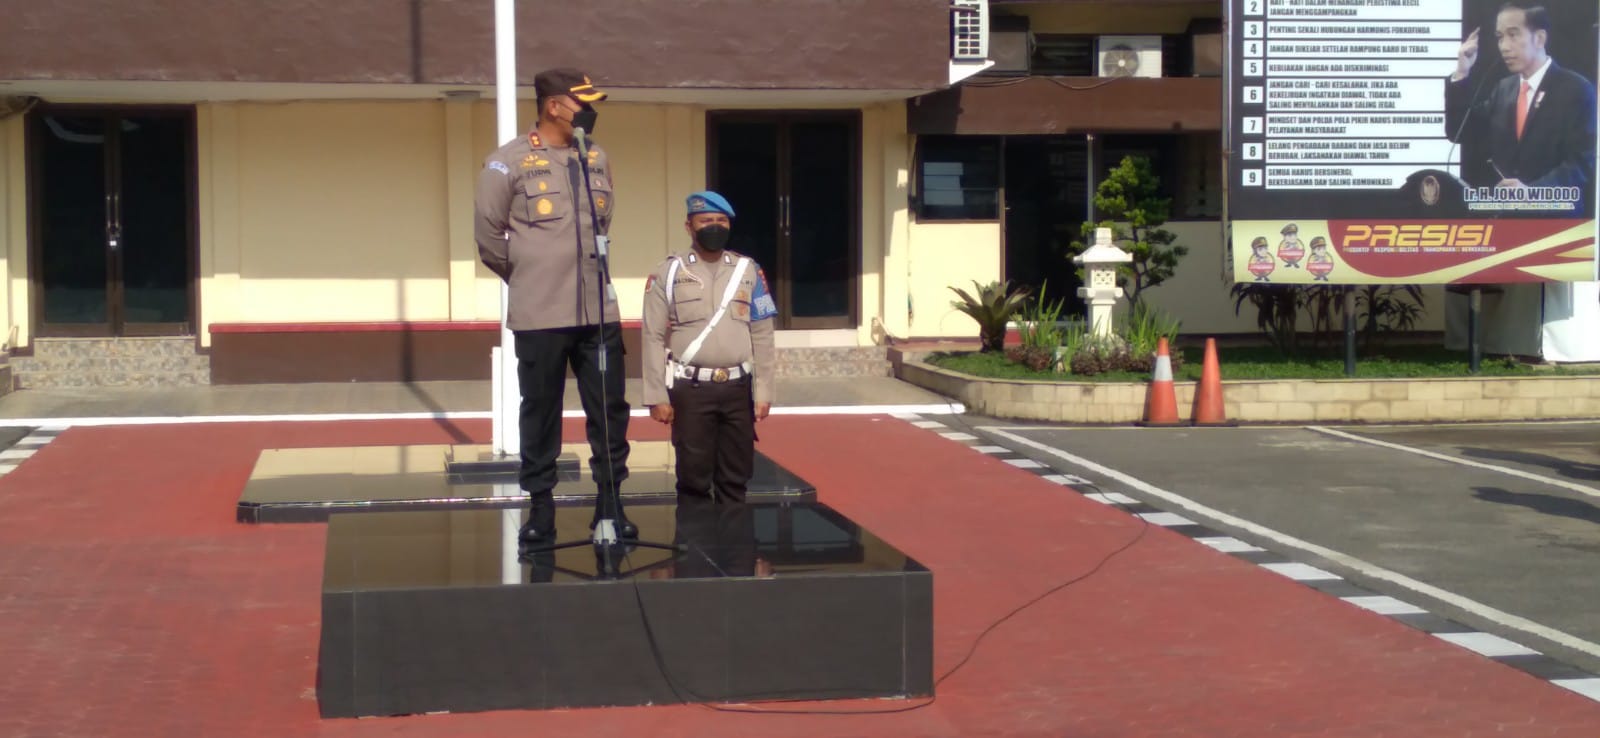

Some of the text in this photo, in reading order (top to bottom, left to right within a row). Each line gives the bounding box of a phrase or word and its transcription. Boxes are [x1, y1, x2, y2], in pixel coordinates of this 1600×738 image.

[1250, 2, 1257, 13] 2
[1269, 8, 1358, 16] JANGAN MENGGAMPANGKAN
[1250, 24, 1257, 35] 3
[1269, 26, 1296, 34] PENTING
[1297, 26, 1319, 34] SEKALI
[1320, 26, 1356, 34] HUBUNGAN
[1357, 26, 1390, 34] HARMONIS
[1250, 44, 1257, 55] 4
[1269, 45, 1294, 53] JANGAN
[1295, 45, 1321, 53] DIKEJAR
[1322, 45, 1348, 53] SETELAH
[1349, 45, 1381, 53] RAMPUNG
[1382, 45, 1400, 53] BARU
[1401, 45, 1408, 53] DI
[1250, 63, 1257, 74] 5
[1269, 64, 1390, 72] KEBIJAKAN JANGAN ADA DISKRIMINASI
[1269, 81, 1294, 89] JANGAN
[1295, 81, 1310, 89] CARI
[1315, 81, 1331, 89] CARI
[1370, 81, 1384, 89] JIKA
[1250, 89, 1257, 100] 6
[1308, 91, 1340, 99] INGATKAN
[1368, 91, 1387, 99] TIDAK
[1388, 91, 1402, 99] ADA
[1269, 101, 1396, 109] SALING MENYALAHKAN DAN SALING JEGAL
[1268, 116, 1297, 124] MINDSET
[1298, 116, 1311, 124] DAN
[1334, 116, 1350, 124] POLA
[1351, 116, 1369, 124] PIKIR
[1370, 116, 1391, 124] HARUS
[1422, 116, 1444, 124] DALAM
[1250, 119, 1256, 131] 7
[1268, 126, 1347, 134] PELAYANAN MASYARAKAT
[1268, 142, 1410, 150] LELANG PENGADAAN BARANG DAN JASA BELUM
[1249, 145, 1257, 157] 8
[1301, 152, 1342, 160] LAKSANAKAN
[1369, 152, 1390, 160] TAHUN
[1268, 168, 1290, 176] SEMUA
[1291, 168, 1313, 176] HARUS
[1249, 172, 1256, 183] 9
[1268, 178, 1393, 186] BEKERJASAMA DAN SALING KOMUNIKASI
[1465, 187, 1580, 201] Ir. H. JOKO WIDODO
[1343, 225, 1493, 246] PRESISI
